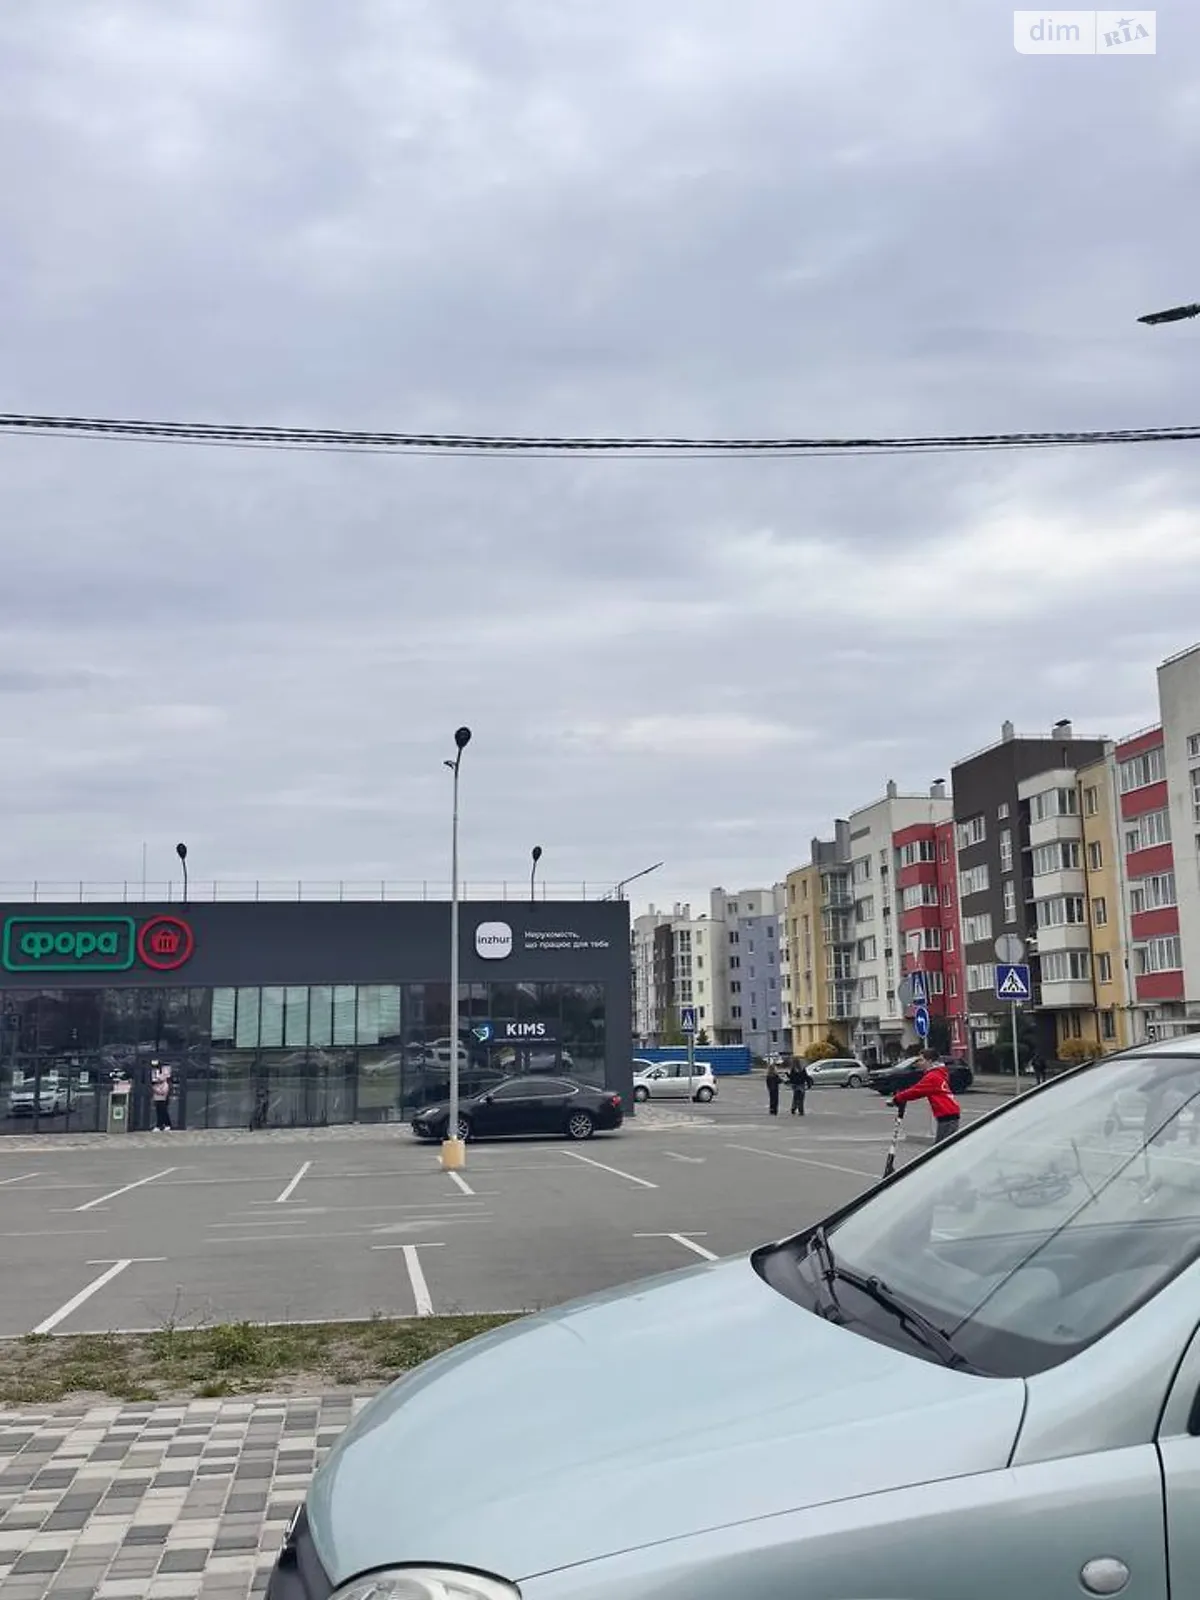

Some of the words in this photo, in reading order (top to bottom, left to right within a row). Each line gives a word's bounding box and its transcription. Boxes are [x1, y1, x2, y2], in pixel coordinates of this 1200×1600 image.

[21, 931, 118, 959] фора
[478, 935, 511, 945] inzhur
[506, 1023, 546, 1036] KIMS
